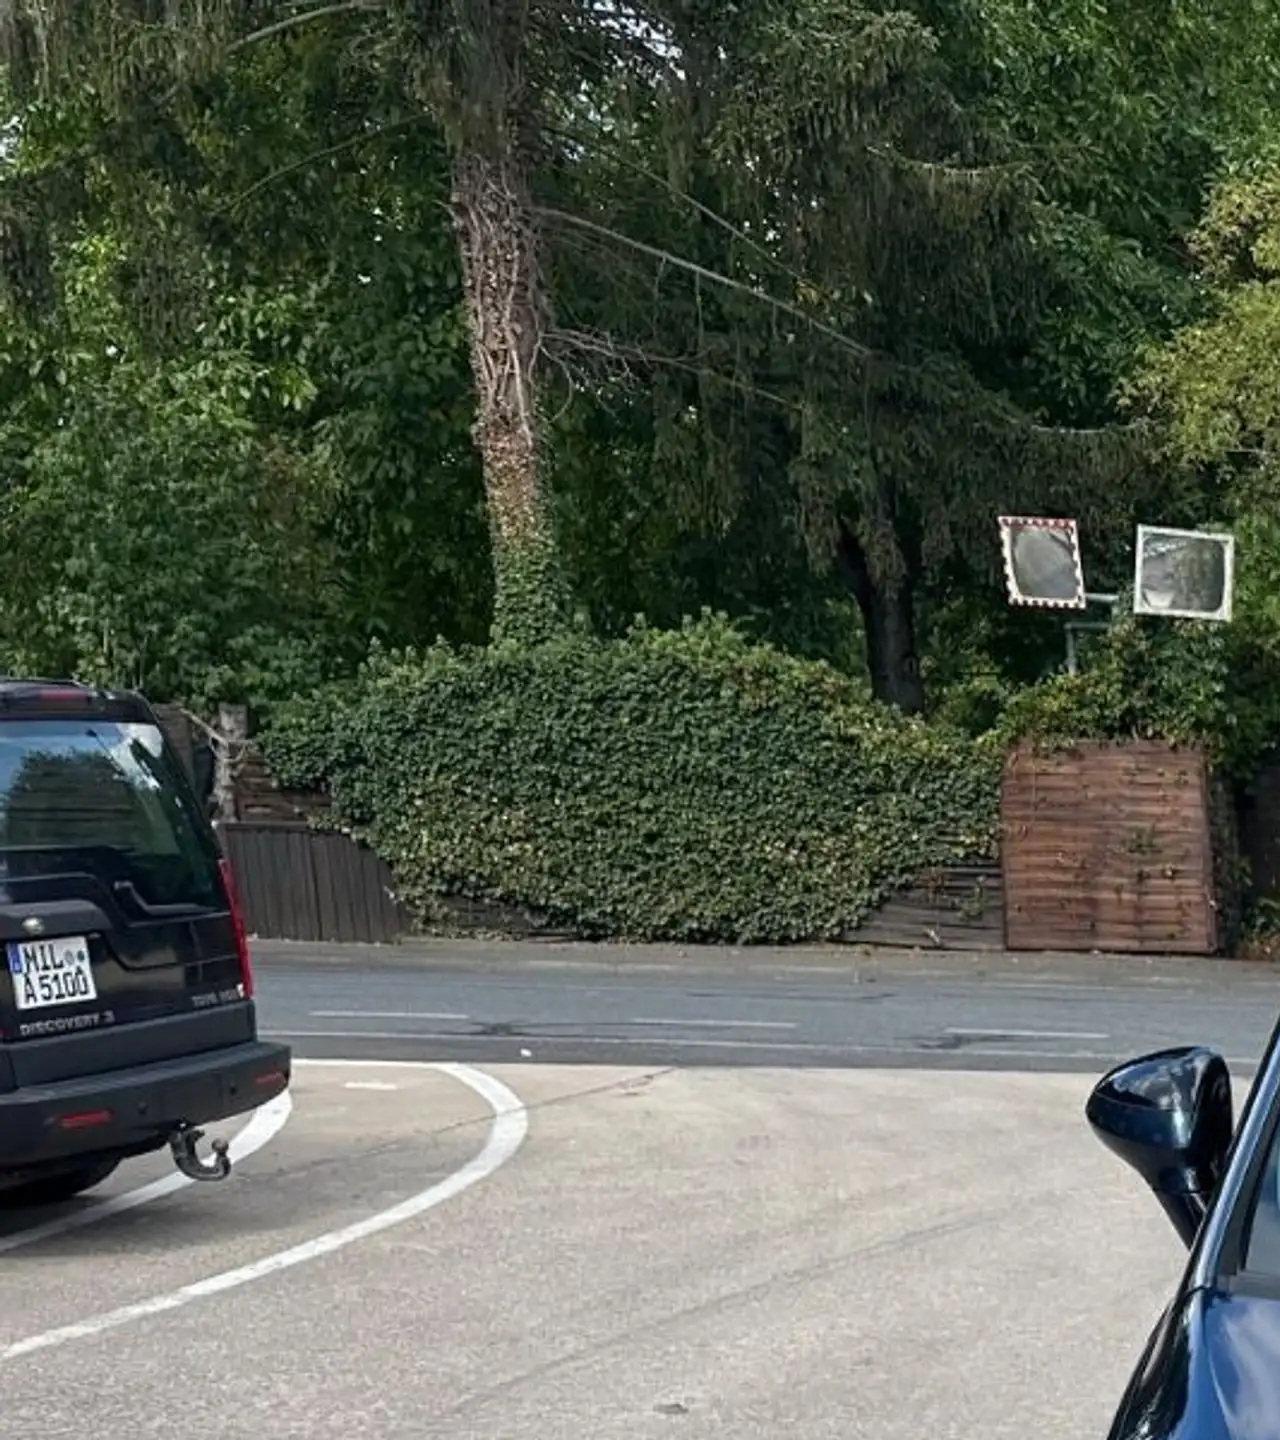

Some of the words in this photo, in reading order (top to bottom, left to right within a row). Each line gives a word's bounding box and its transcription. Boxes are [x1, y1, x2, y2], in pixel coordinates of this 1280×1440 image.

[23, 944, 64, 972] MIL
[24, 973, 37, 1003] A
[39, 969, 89, 1001] 5100
[20, 1012, 99, 1036] DISCOVERY
